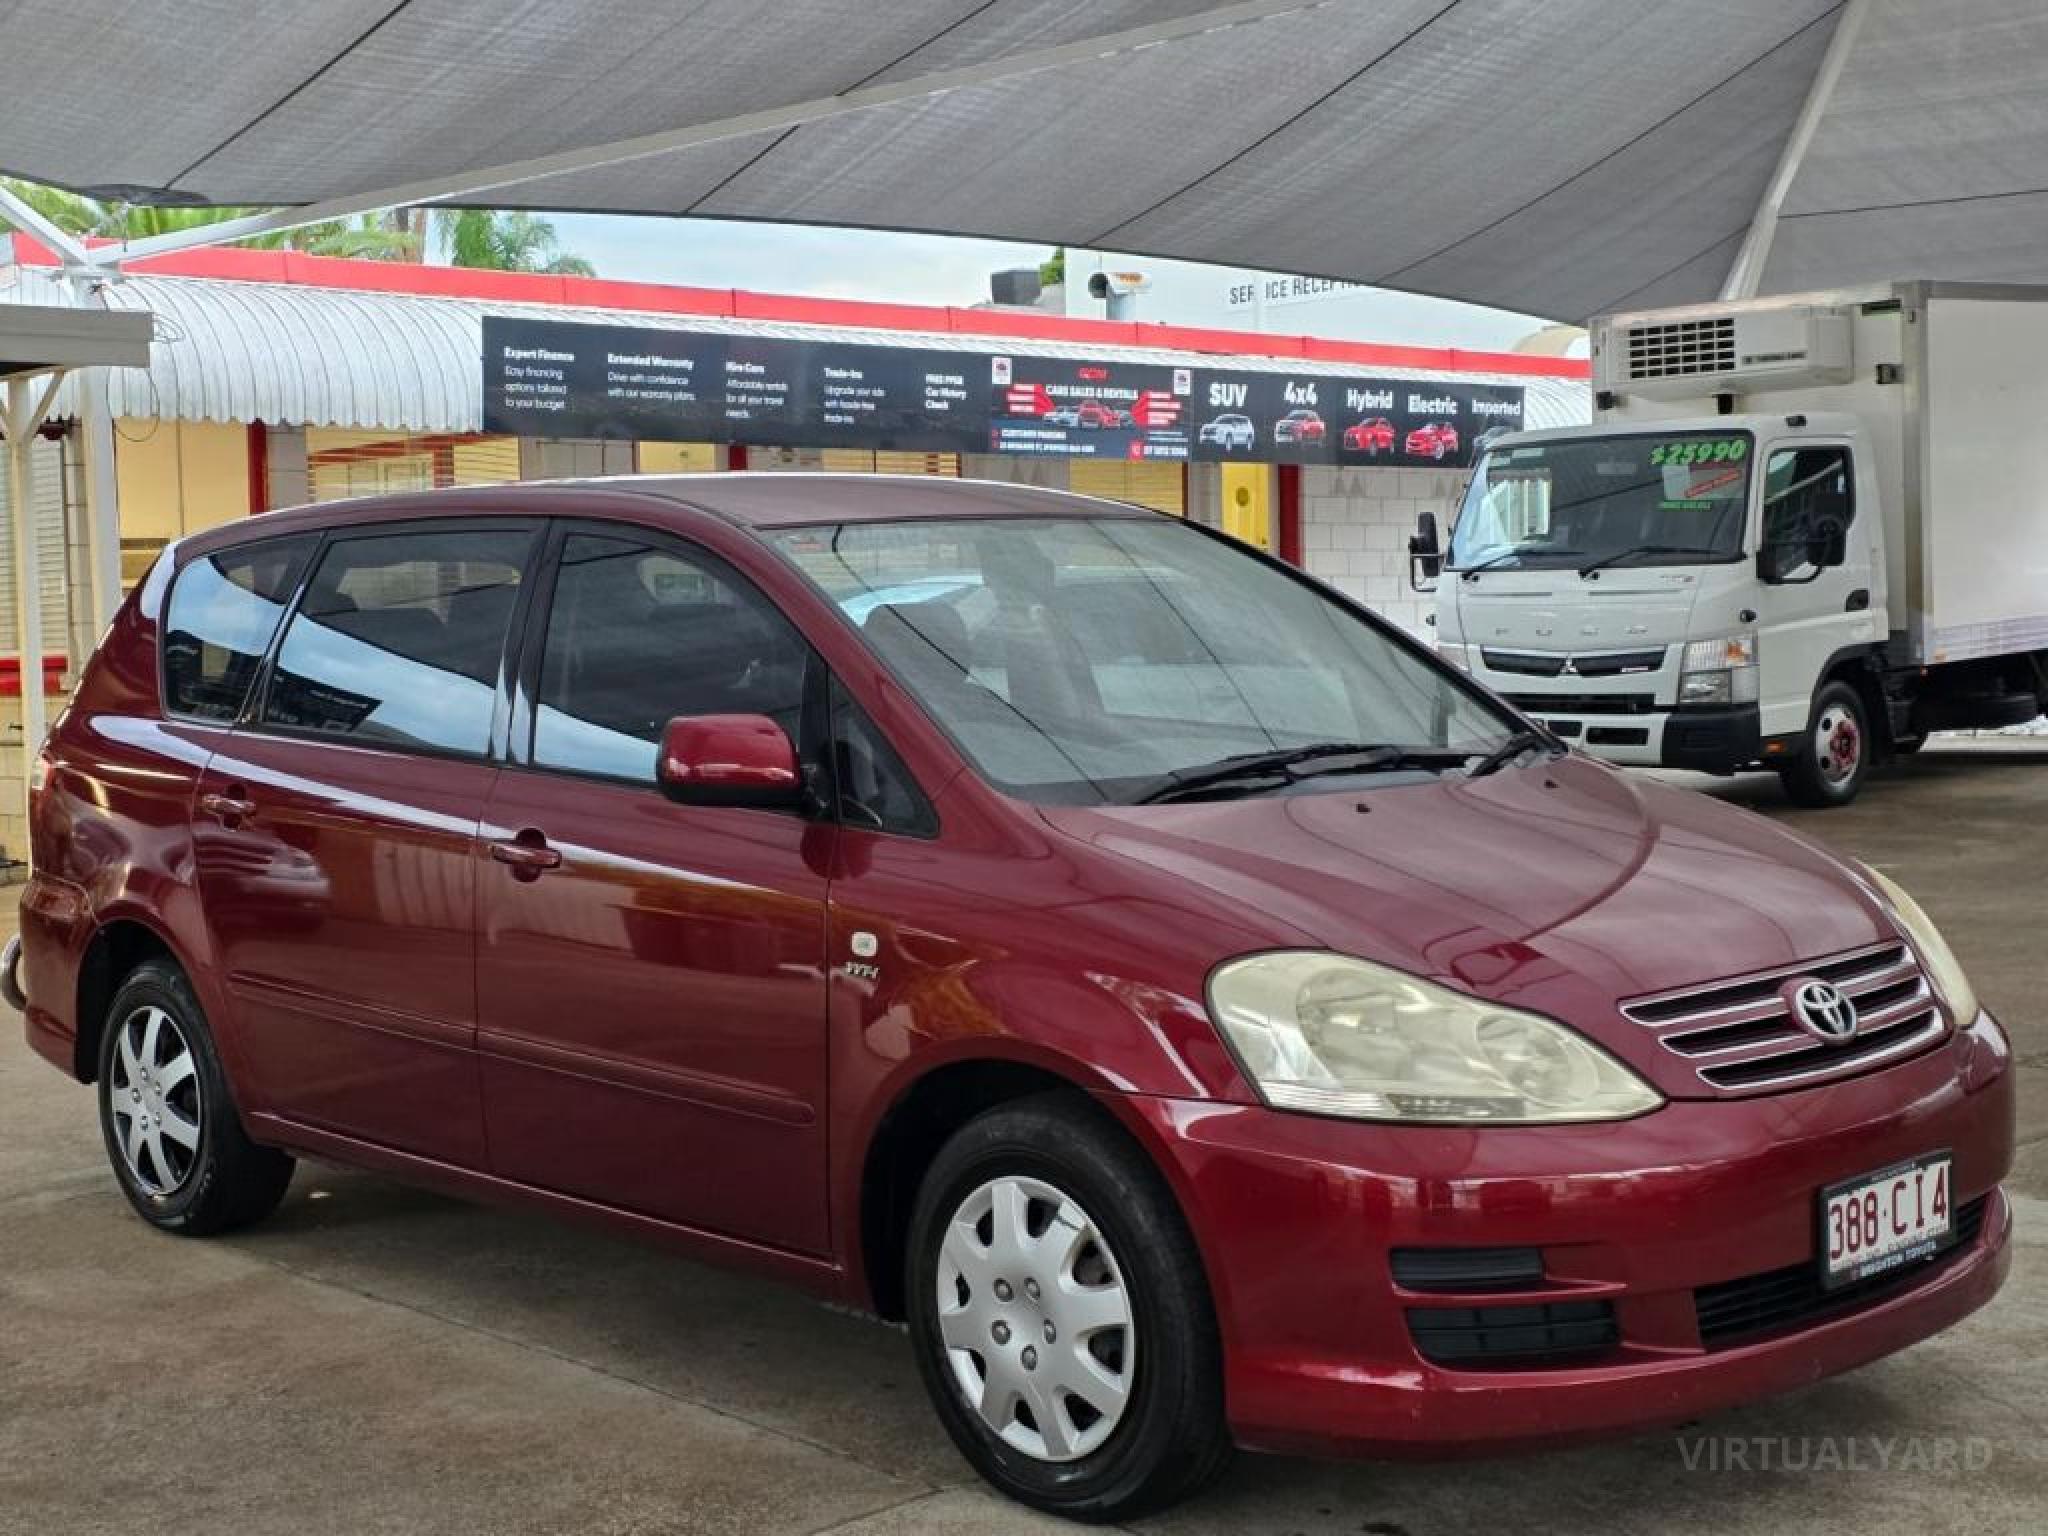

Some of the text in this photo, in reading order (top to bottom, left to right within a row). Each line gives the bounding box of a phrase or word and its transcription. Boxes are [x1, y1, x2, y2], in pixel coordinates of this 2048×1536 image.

[504, 346, 575, 361] Expert Finance
[608, 352, 694, 370] Extended Warranty
[504, 366, 563, 380] Easy financing
[608, 372, 628, 382] Drive
[645, 375, 689, 385] confidence
[505, 383, 567, 394] options tailored
[639, 391, 673, 401] warranty
[1209, 383, 1249, 407] SUV
[1284, 381, 1319, 405] 4x4
[505, 399, 514, 407] to
[515, 400, 533, 409] your
[1347, 388, 1393, 413] Hybrid
[1408, 393, 1457, 415] Electric
[1471, 399, 1520, 416] Imported
